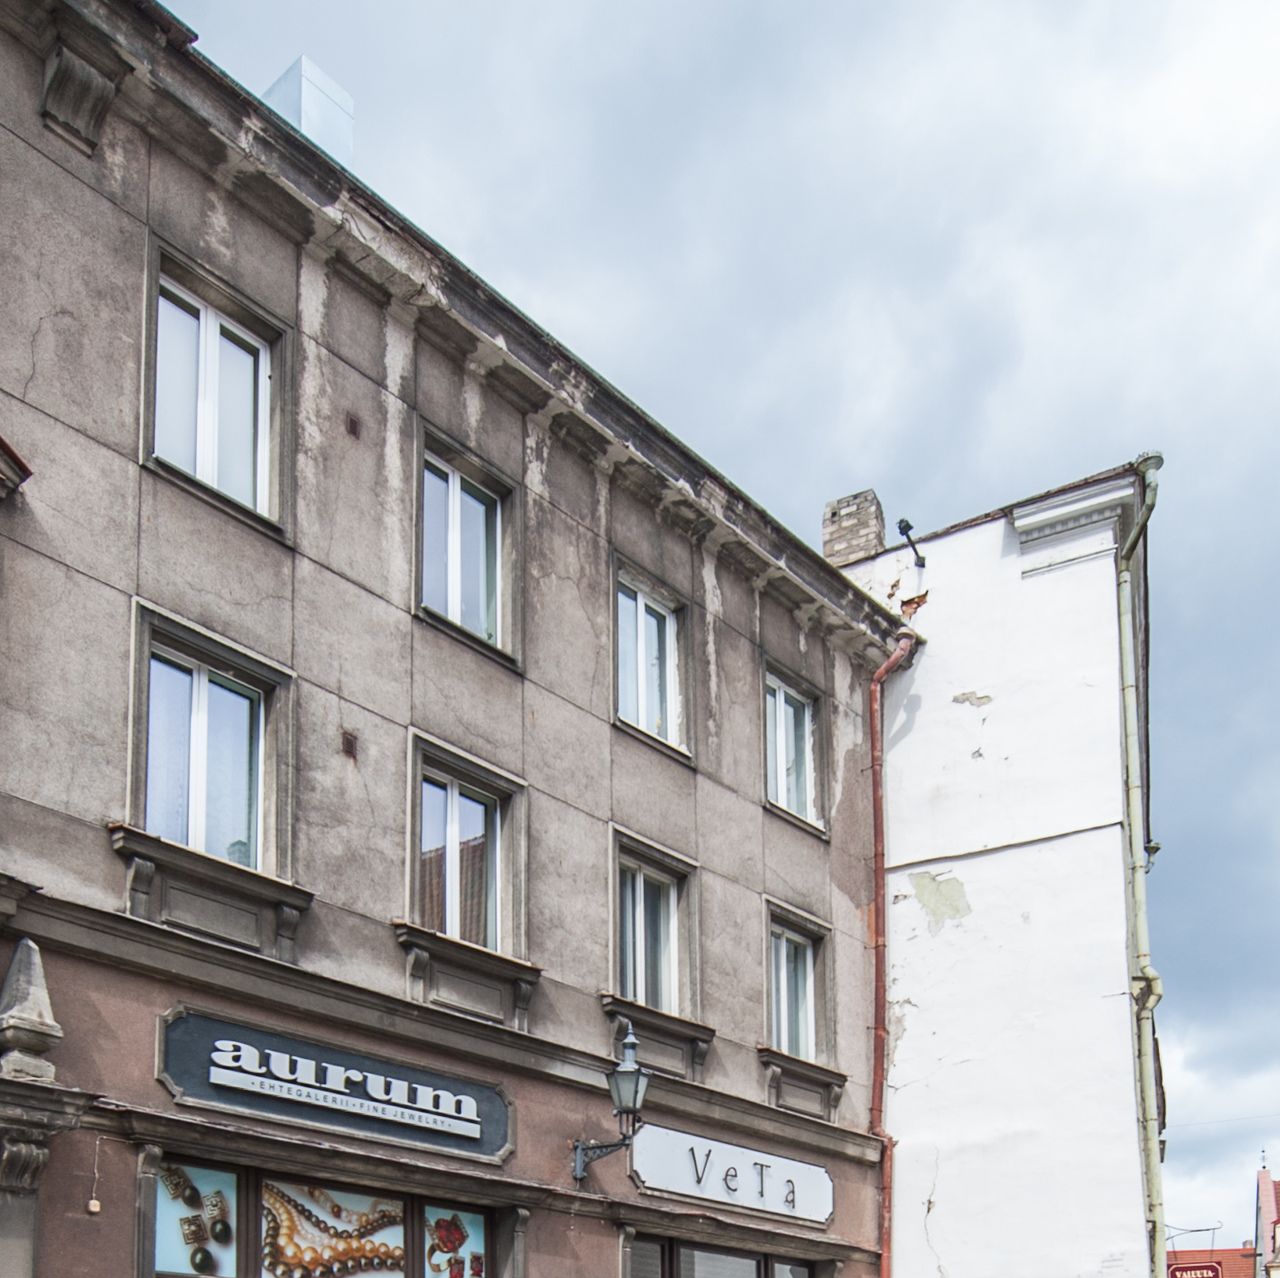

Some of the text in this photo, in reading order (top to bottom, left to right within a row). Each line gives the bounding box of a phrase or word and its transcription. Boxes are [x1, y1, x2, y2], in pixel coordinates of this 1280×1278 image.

[210, 1039, 482, 1121] aurum
[258, 1081, 446, 1128] EHTEGALERII FINE JEWELRY
